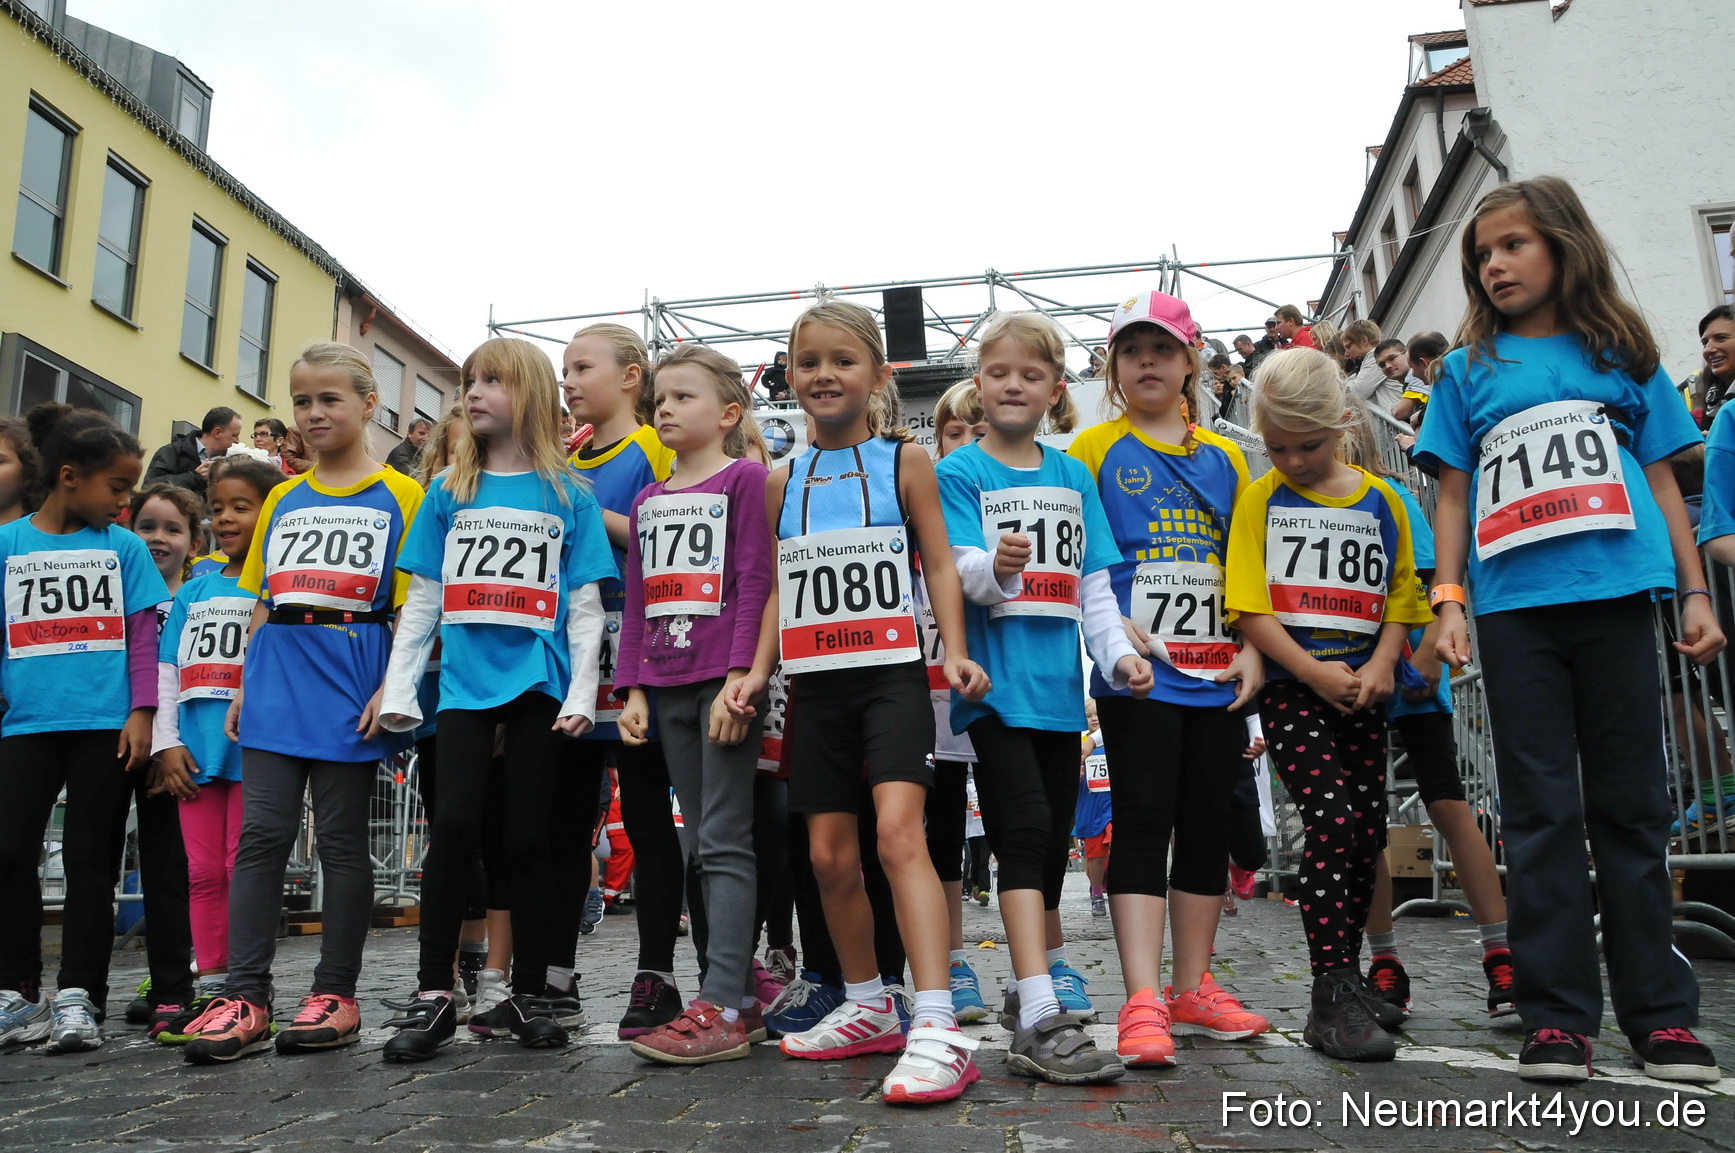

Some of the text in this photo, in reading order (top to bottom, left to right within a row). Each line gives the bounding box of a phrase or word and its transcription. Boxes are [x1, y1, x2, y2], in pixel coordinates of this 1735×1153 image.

[1480, 412, 1585, 460] ARTL Neumarkt
[1483, 429, 1608, 505] 7149
[1124, 476, 1145, 484] Jahre
[652, 505, 703, 519] Neumarkt
[985, 499, 1080, 516] PARTL Neumarkt
[1519, 493, 1579, 524] Leoni
[312, 516, 369, 526] Neumarkt
[486, 519, 545, 534] Neumarkt
[1271, 517, 1377, 536] PARTL Neumarkt
[278, 529, 374, 568] 7203
[639, 523, 713, 569] 7179
[780, 541, 885, 565] PARTL Neumarkt
[44, 560, 102, 571] Neumarkt
[456, 535, 548, 583] 7221
[1282, 536, 1383, 587] 7186
[291, 574, 336, 591] Mona
[788, 560, 901, 619] 7080
[1024, 578, 1073, 599] Kristin
[1136, 575, 1180, 585] PARTL
[19, 575, 113, 616] 7504
[467, 589, 526, 609] Carolin
[645, 579, 683, 603] Sophia
[207, 607, 253, 617] Neumark
[1298, 592, 1362, 613] Antonia
[1146, 592, 1232, 638] 7215
[28, 622, 88, 641] Victoria
[187, 622, 250, 660] 750
[815, 628, 874, 650] Felina
[68, 642, 88, 651] 2006
[1168, 648, 1229, 664] atharina
[1091, 764, 1107, 778] 75
